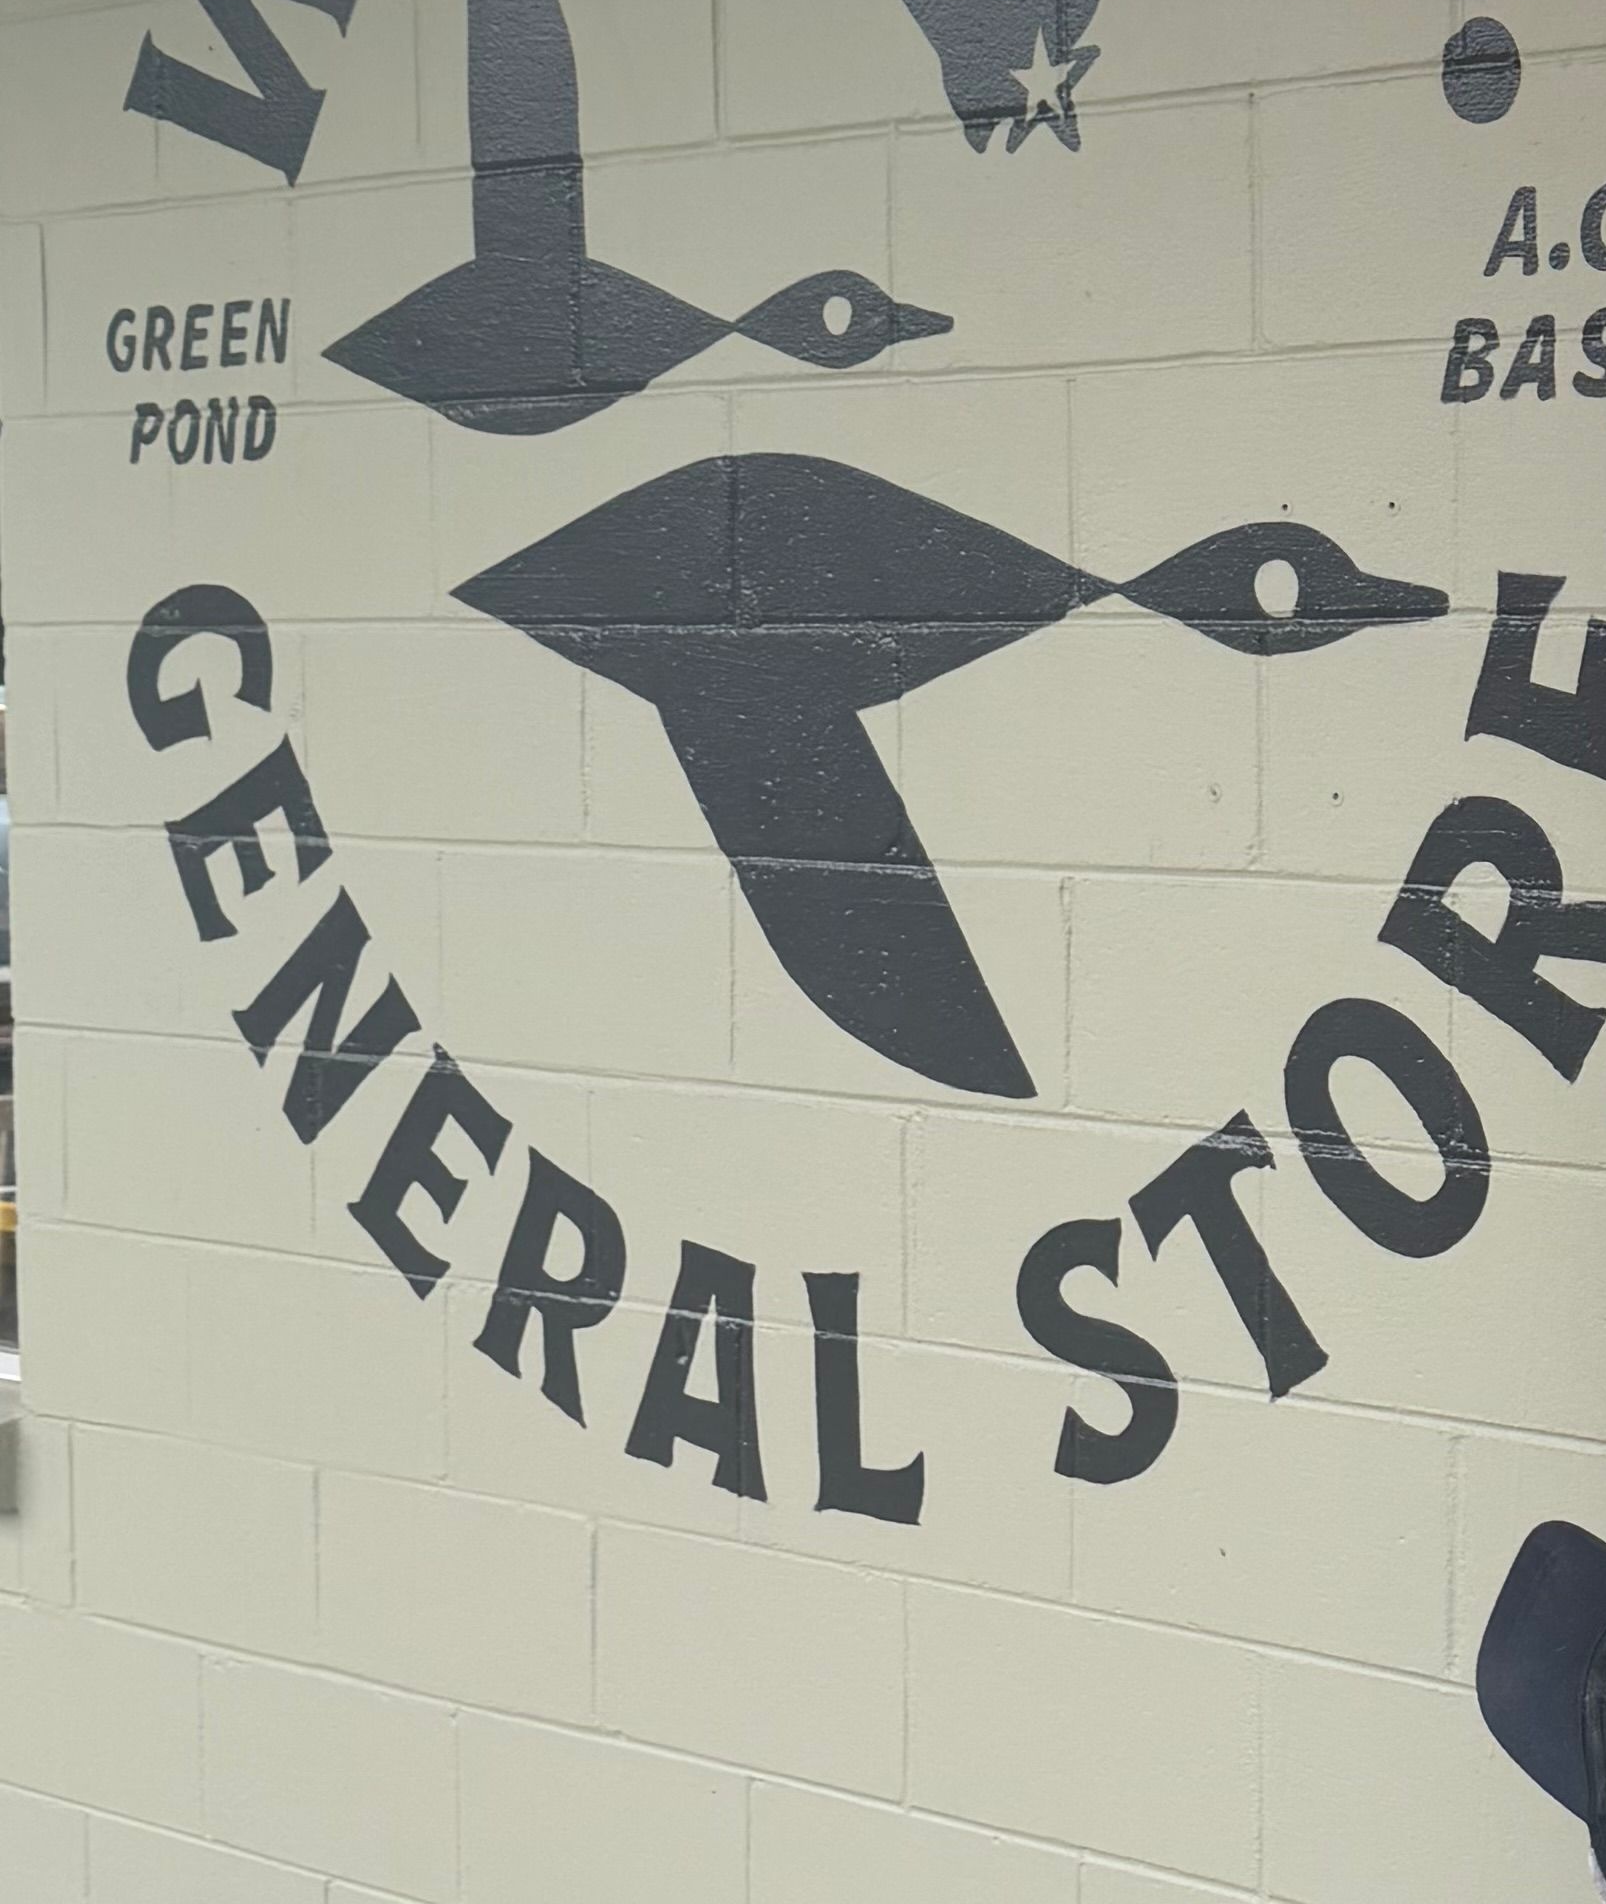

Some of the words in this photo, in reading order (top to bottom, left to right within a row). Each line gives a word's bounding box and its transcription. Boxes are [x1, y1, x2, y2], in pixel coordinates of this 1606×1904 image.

[106, 298, 291, 373] GREEN
[130, 395, 277, 465] POND
[127, 584, 926, 1524] GENERAL
